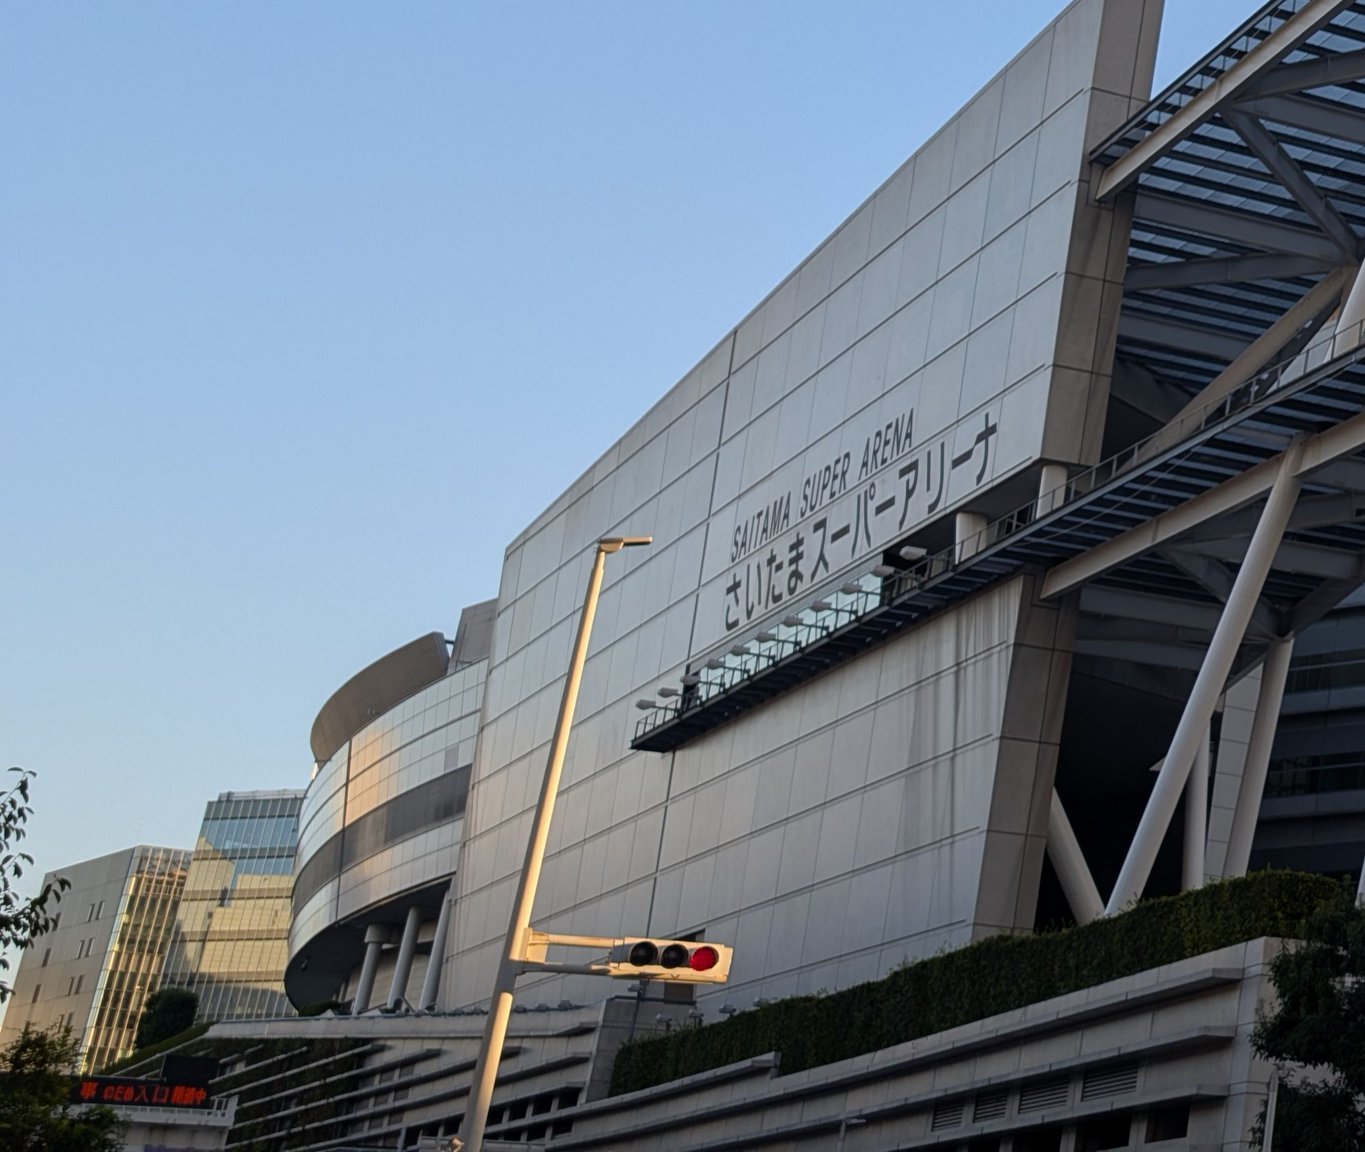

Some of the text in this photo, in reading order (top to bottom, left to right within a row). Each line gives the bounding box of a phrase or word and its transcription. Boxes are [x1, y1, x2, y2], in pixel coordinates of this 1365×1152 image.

[725, 412, 997, 632] さいたまスーパーアリーナ
[731, 407, 914, 563] SAITAMA SUPER ARENA
